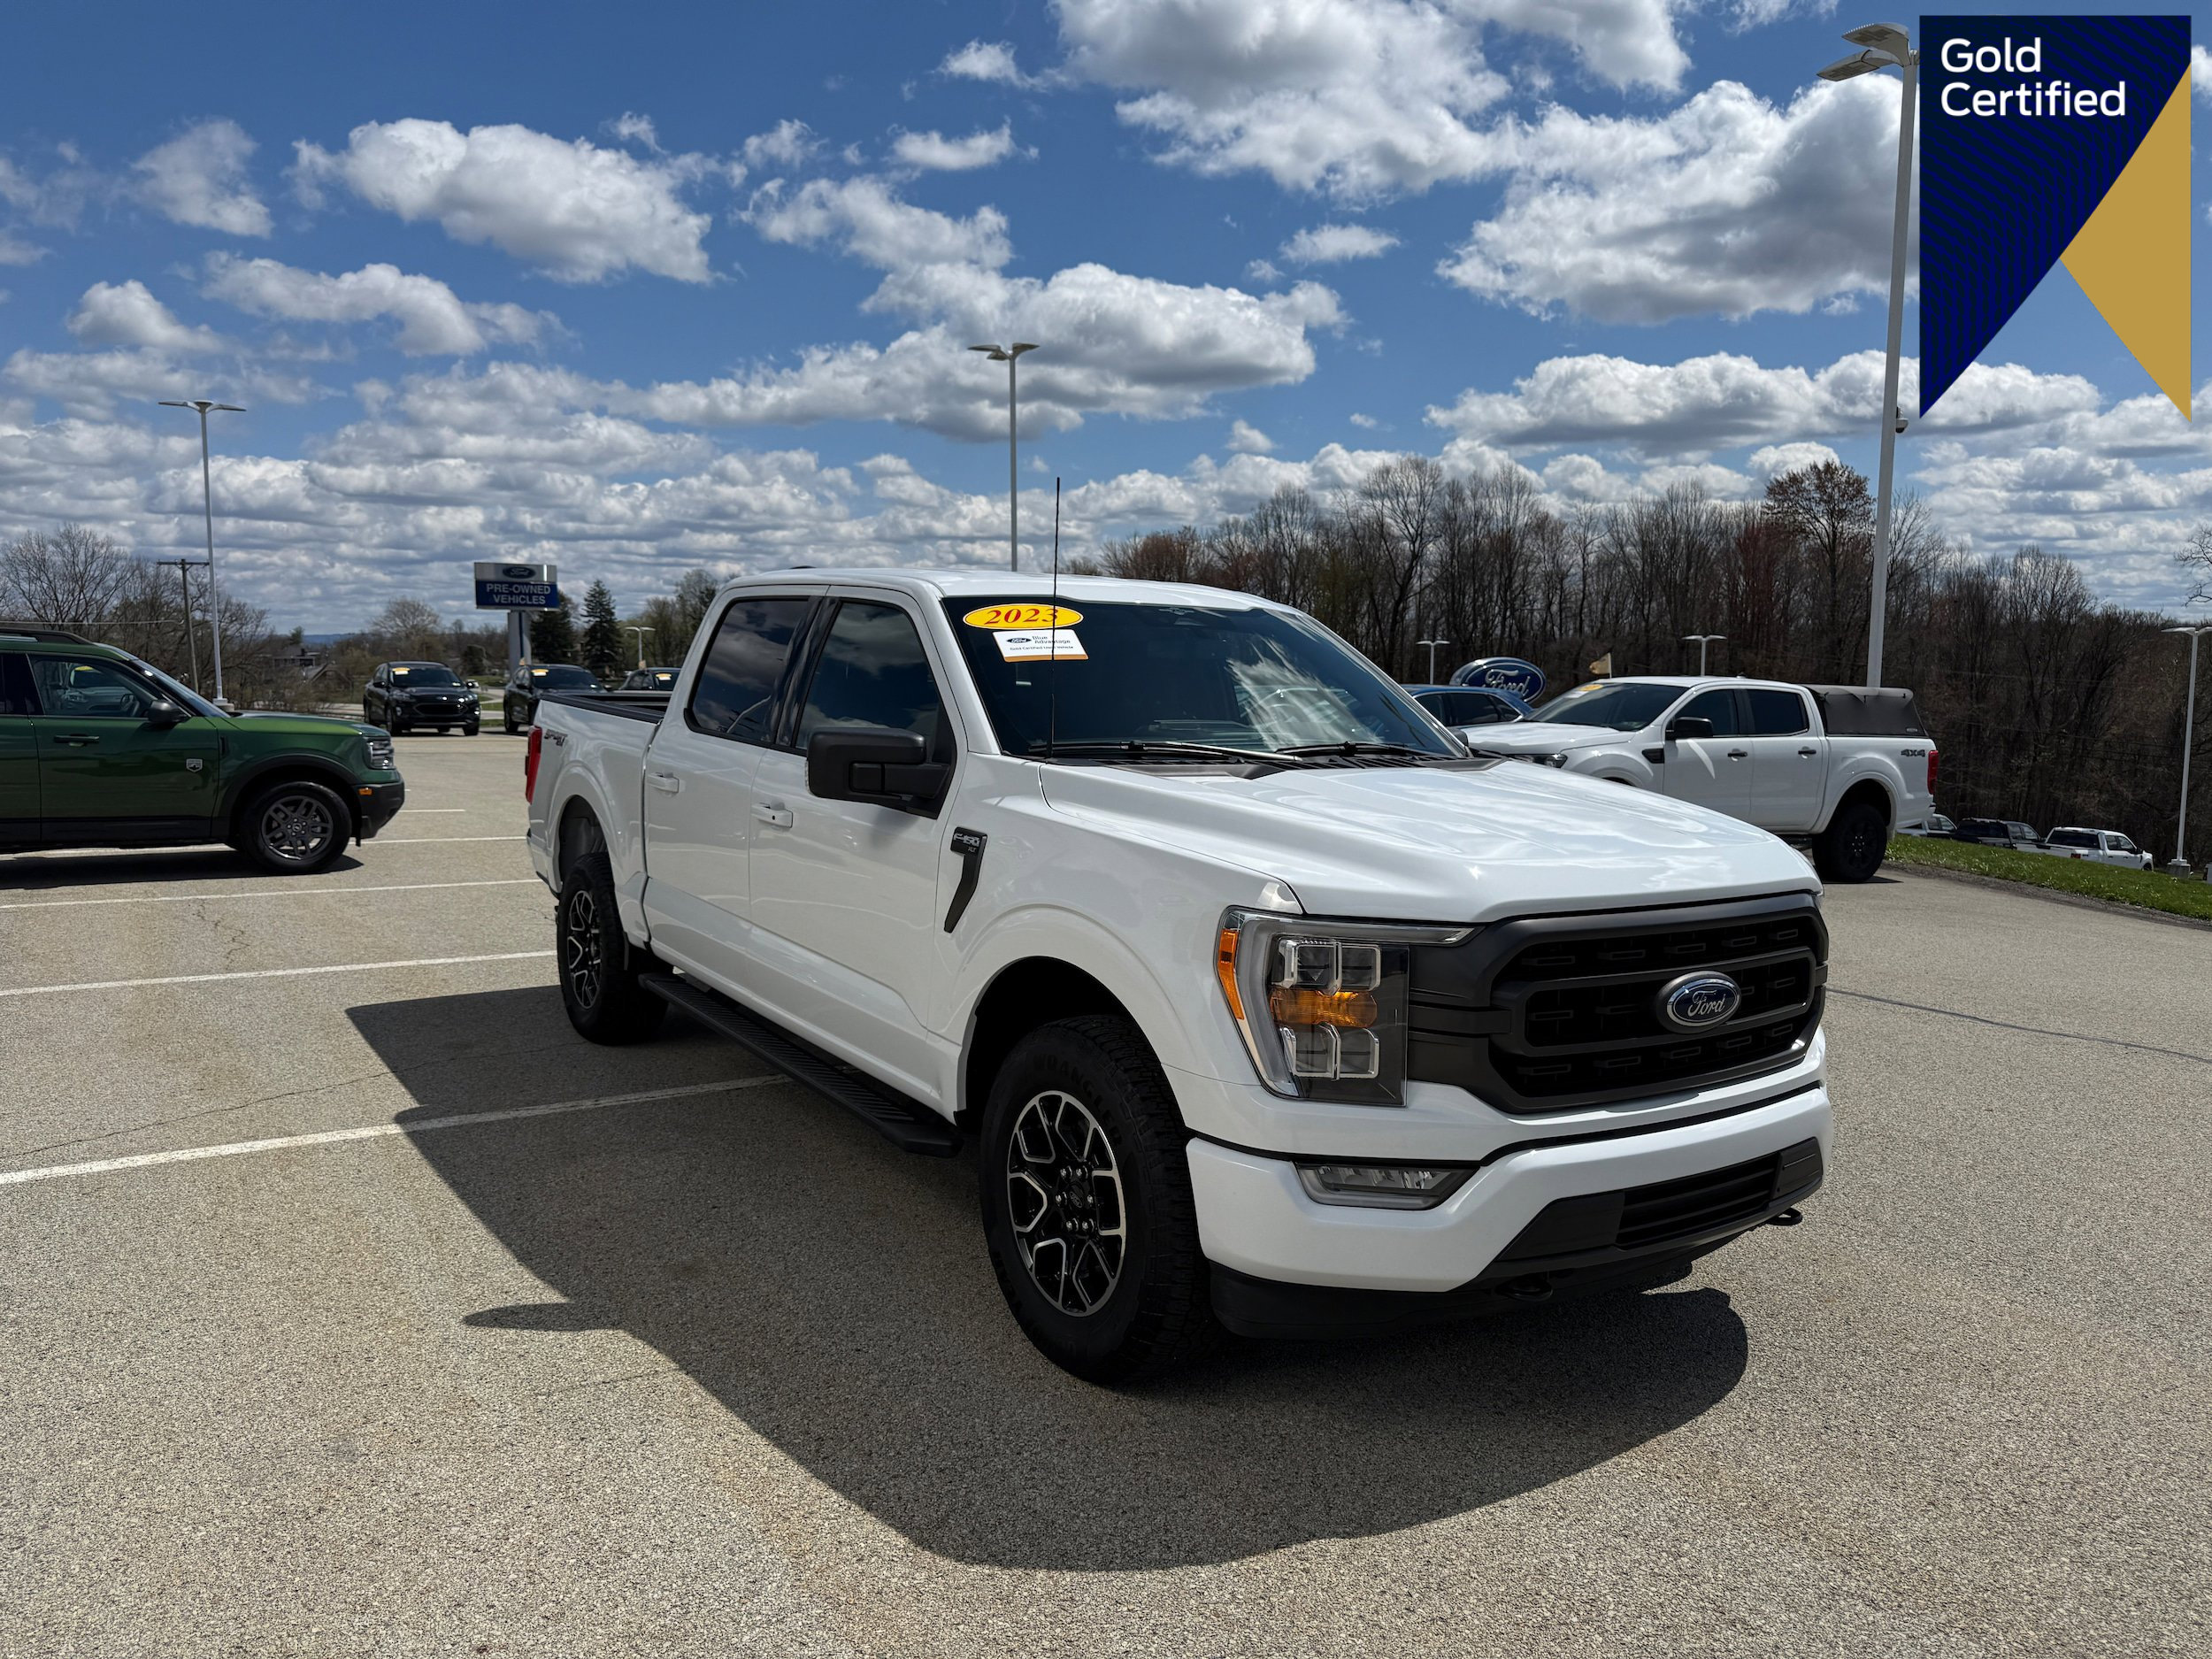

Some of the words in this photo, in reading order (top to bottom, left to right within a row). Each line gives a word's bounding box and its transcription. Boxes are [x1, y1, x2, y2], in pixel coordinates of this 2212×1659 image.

[486, 583, 551, 594] PRE-OWNED
[493, 595, 546, 604] VEHICLES
[984, 608, 1058, 625] 2023
[1485, 668, 1530, 696] Ford
[1687, 989, 1726, 1017] Ford
